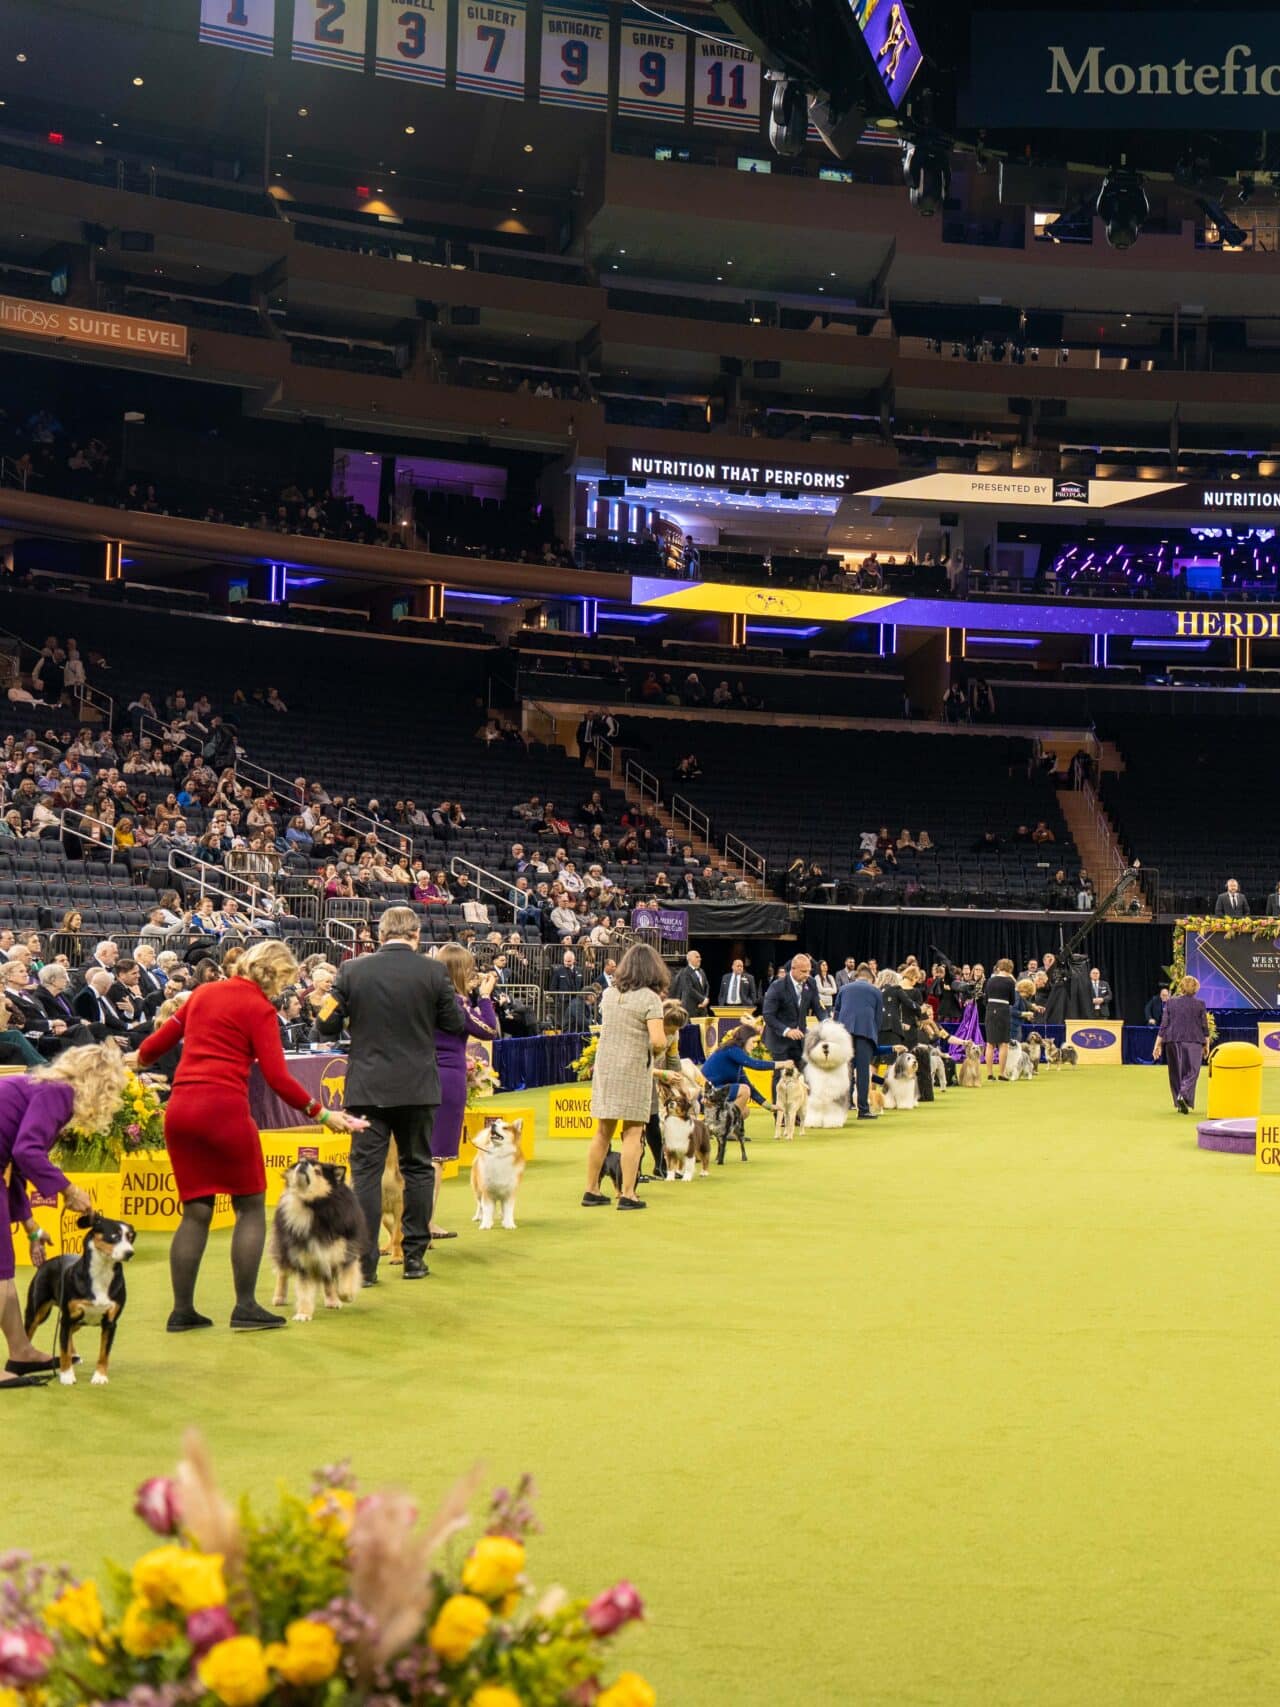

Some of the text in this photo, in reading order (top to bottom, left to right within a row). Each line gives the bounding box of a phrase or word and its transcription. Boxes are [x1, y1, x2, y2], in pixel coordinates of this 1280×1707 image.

[314, 0, 346, 44] 2
[466, 7, 517, 28] GILBERT
[548, 20, 603, 41] BATHGATE
[397, 11, 427, 59] 3
[476, 25, 506, 74] 7
[632, 32, 675, 51] GRAVES
[560, 40, 590, 86] 9
[701, 43, 755, 64] HADFIELD
[639, 51, 667, 97] 9
[707, 60, 748, 110] 11
[0, 302, 180, 348] Infosys SUITE LEVEL
[632, 458, 715, 479] NUTRITION
[721, 466, 759, 482] THAT
[971, 482, 1030, 493] PRESENTED
[555, 1117, 592, 1129] BUHUND
